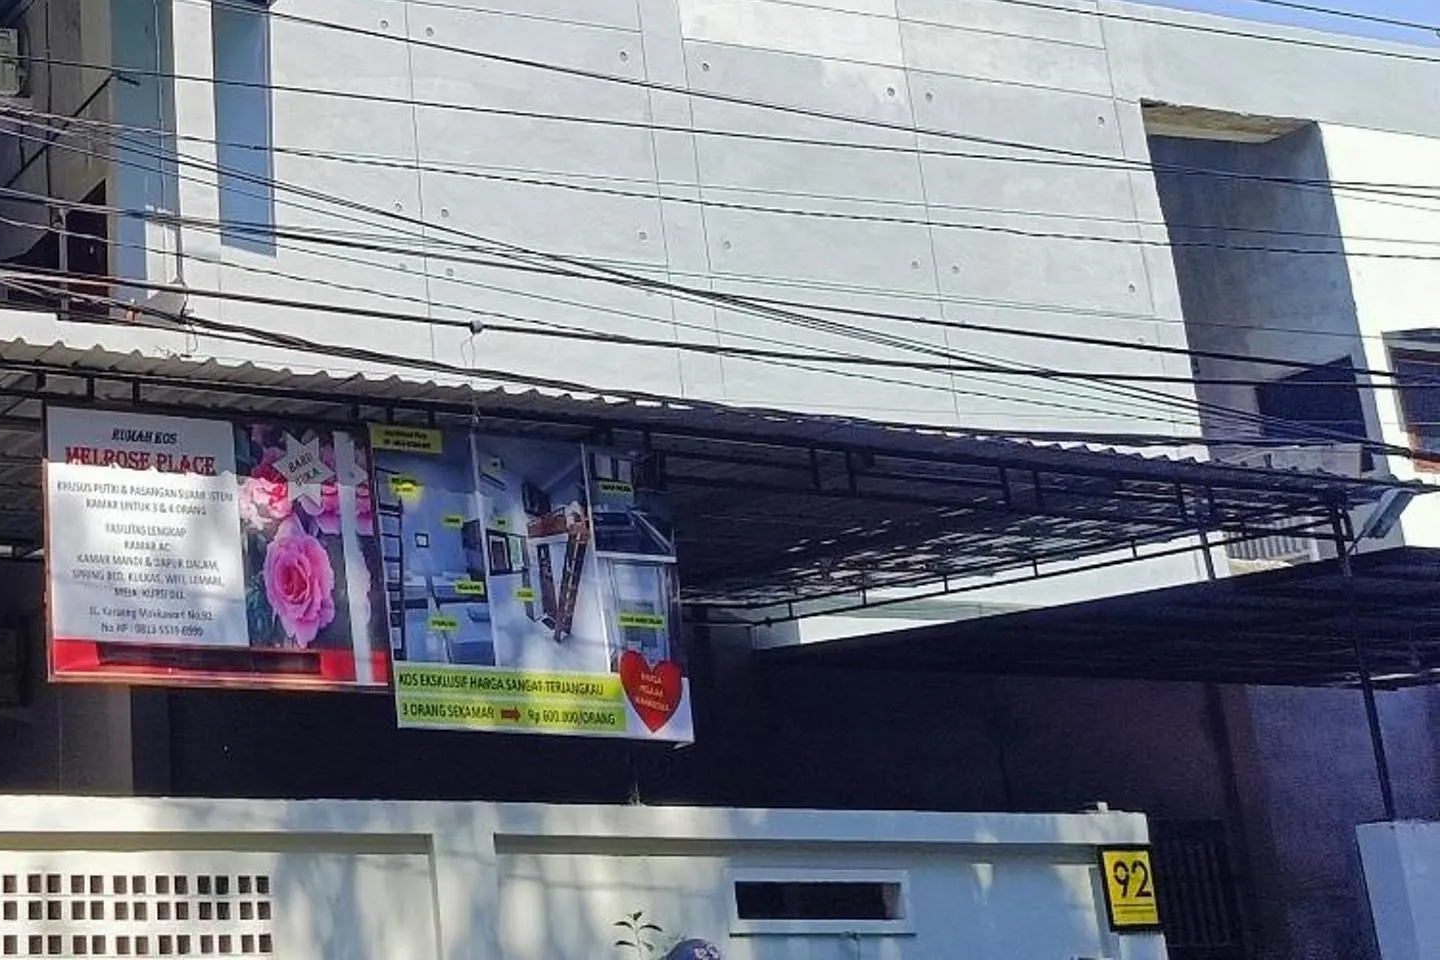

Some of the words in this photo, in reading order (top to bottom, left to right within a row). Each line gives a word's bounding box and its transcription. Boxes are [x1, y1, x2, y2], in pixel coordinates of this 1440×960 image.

[65, 446, 150, 471] MELROSE
[156, 453, 217, 477] PLACE
[398, 673, 419, 687] KOS
[421, 674, 468, 689] EKSKLUSIF
[470, 675, 504, 690] HARGA
[506, 677, 542, 692] SANGAT
[545, 680, 604, 696] TERJANGKAU
[402, 702, 409, 715] 3
[409, 704, 447, 718] ORANG
[447, 705, 495, 719] SEKAMAR
[1112, 859, 1152, 898] 92
